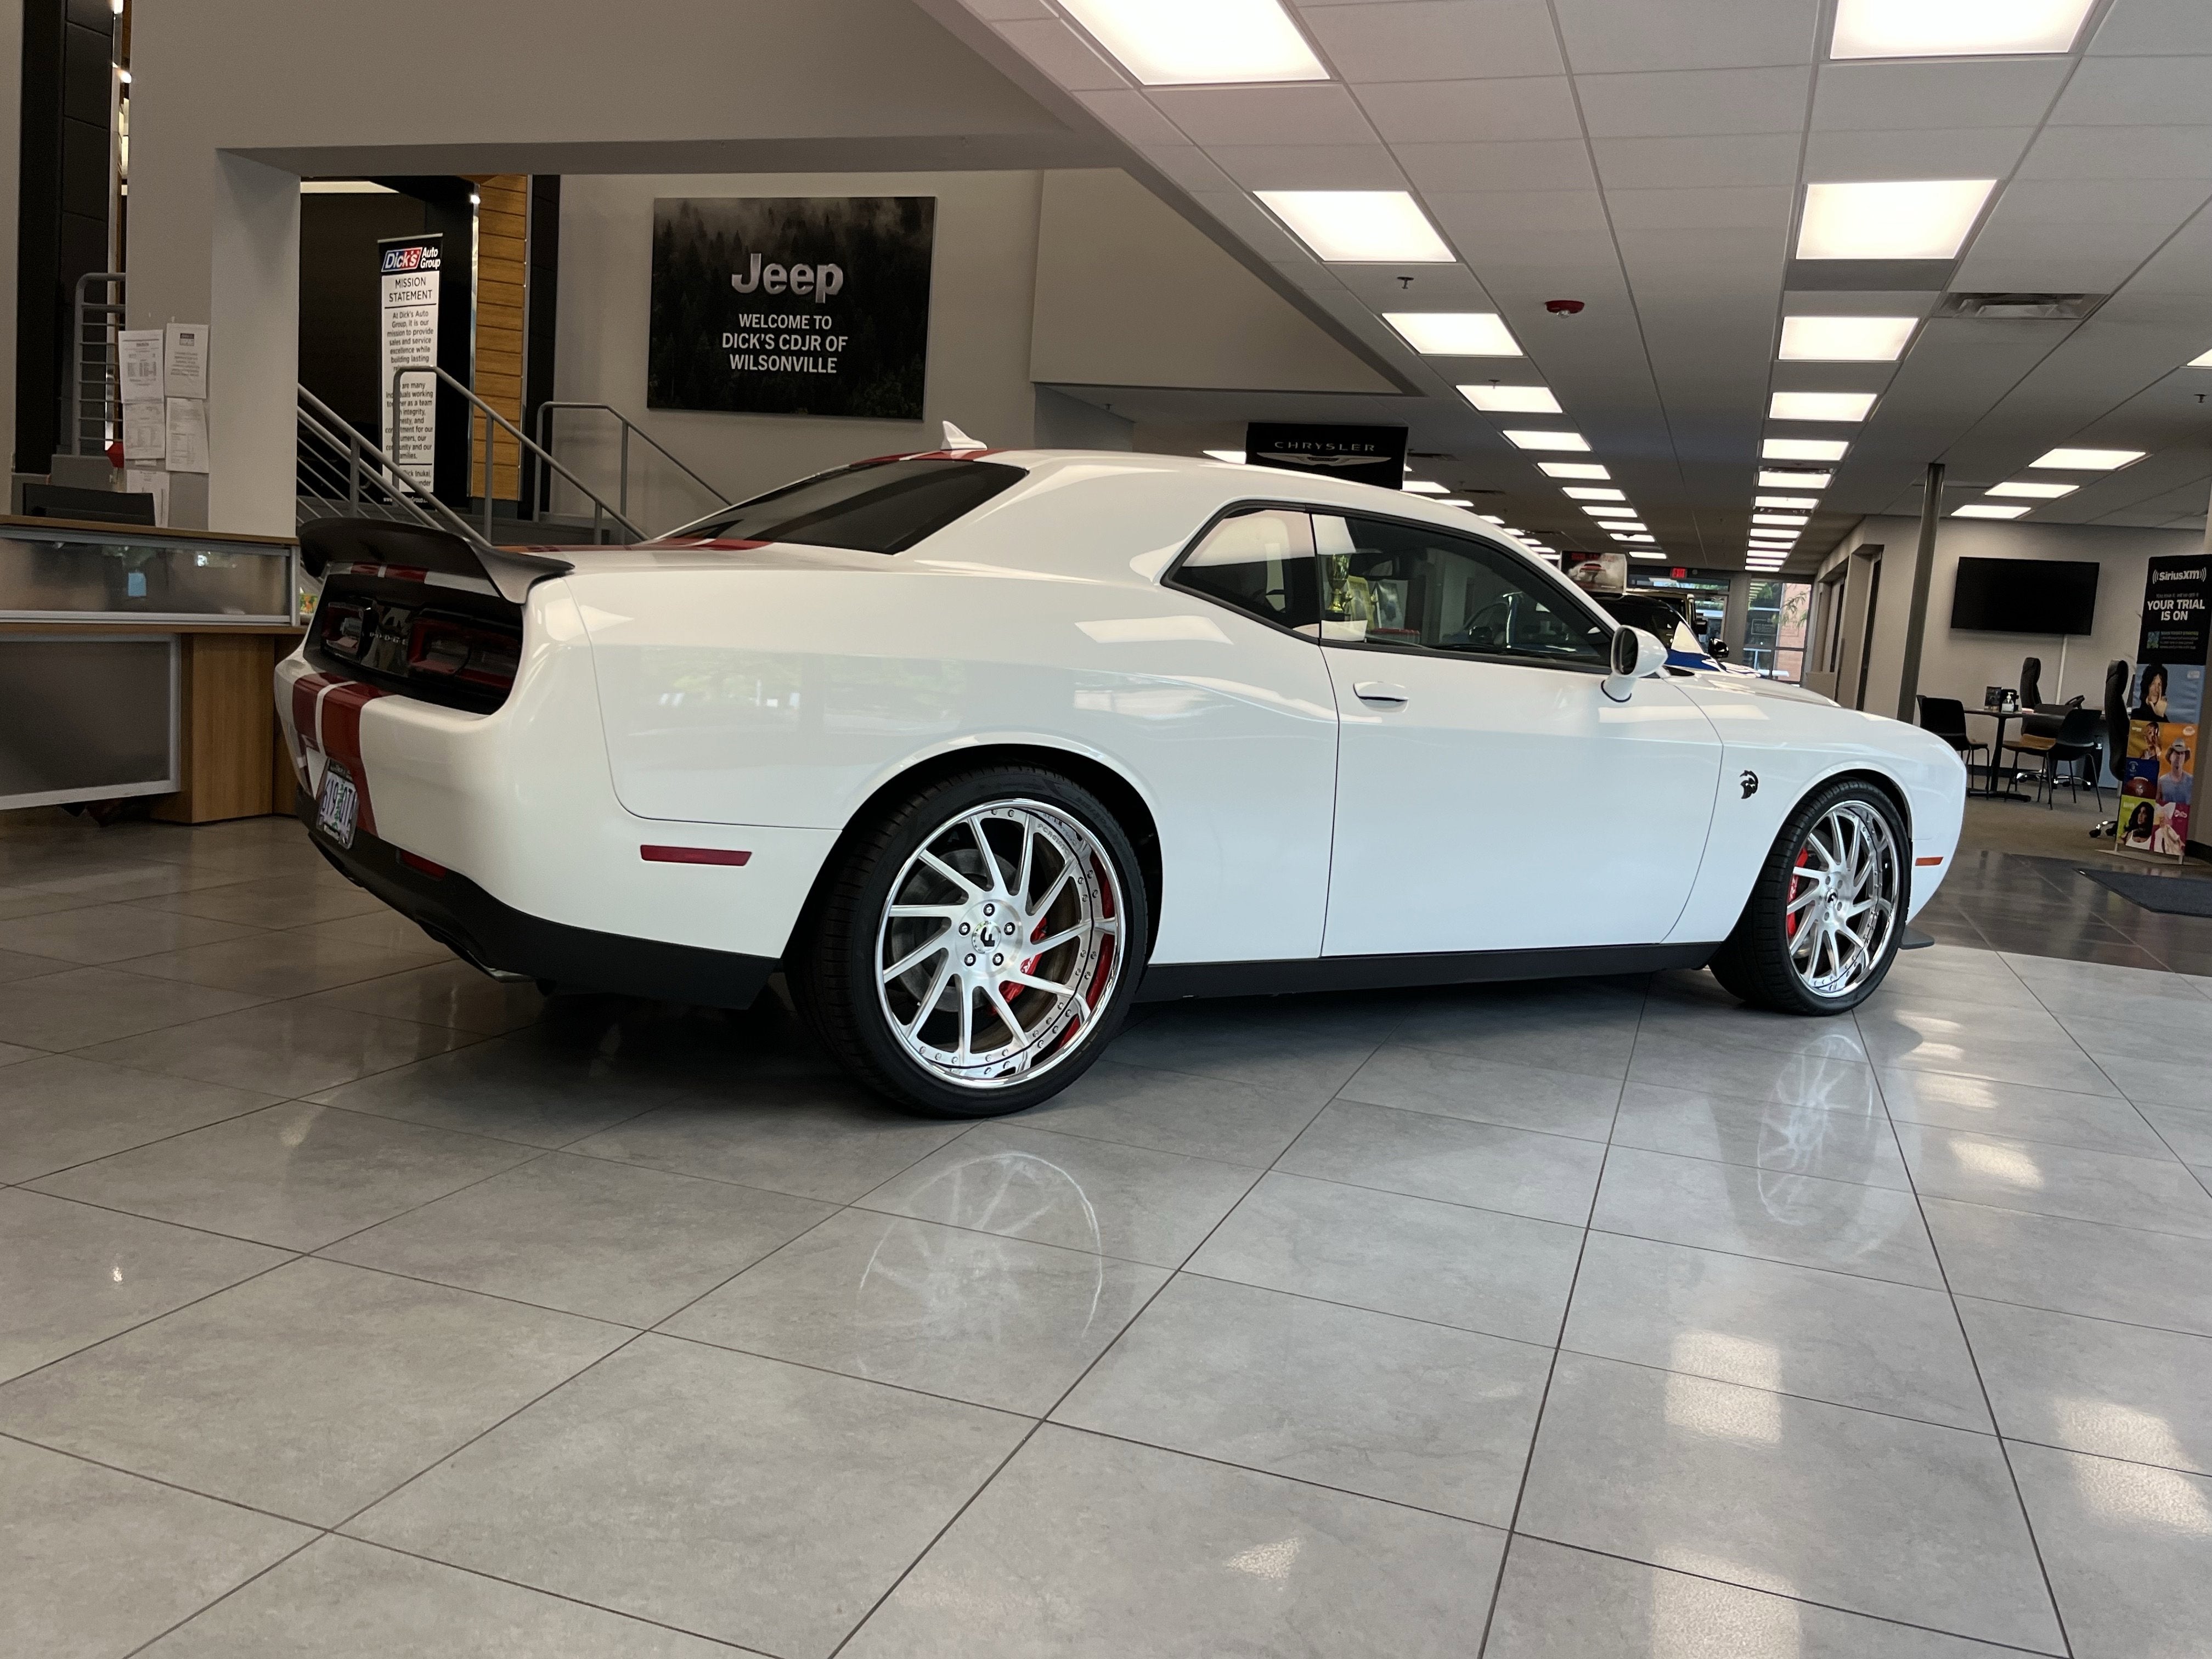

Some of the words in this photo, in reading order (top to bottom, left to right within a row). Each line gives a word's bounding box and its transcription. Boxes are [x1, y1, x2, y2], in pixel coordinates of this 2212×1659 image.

[422, 247, 438, 258] Auto
[385, 251, 418, 269] Dick's
[420, 258, 441, 269] Group
[395, 277, 426, 289] MISSION
[731, 253, 844, 303] Jeep
[389, 290, 432, 302] STATEMENT
[738, 313, 810, 330] WELCOME
[814, 315, 832, 330] TO
[413, 328, 433, 336] provide
[722, 332, 775, 349] DICK'S
[779, 334, 821, 352] CDJR
[826, 336, 848, 352] OF
[729, 354, 837, 373] WILSONVILLE
[1274, 441, 1375, 451] CHRYSLER
[2147, 600, 2174, 610] YOUR
[2176, 599, 2205, 610] TRIAL
[2161, 611, 2170, 620] IS
[2173, 611, 2188, 620] ON
